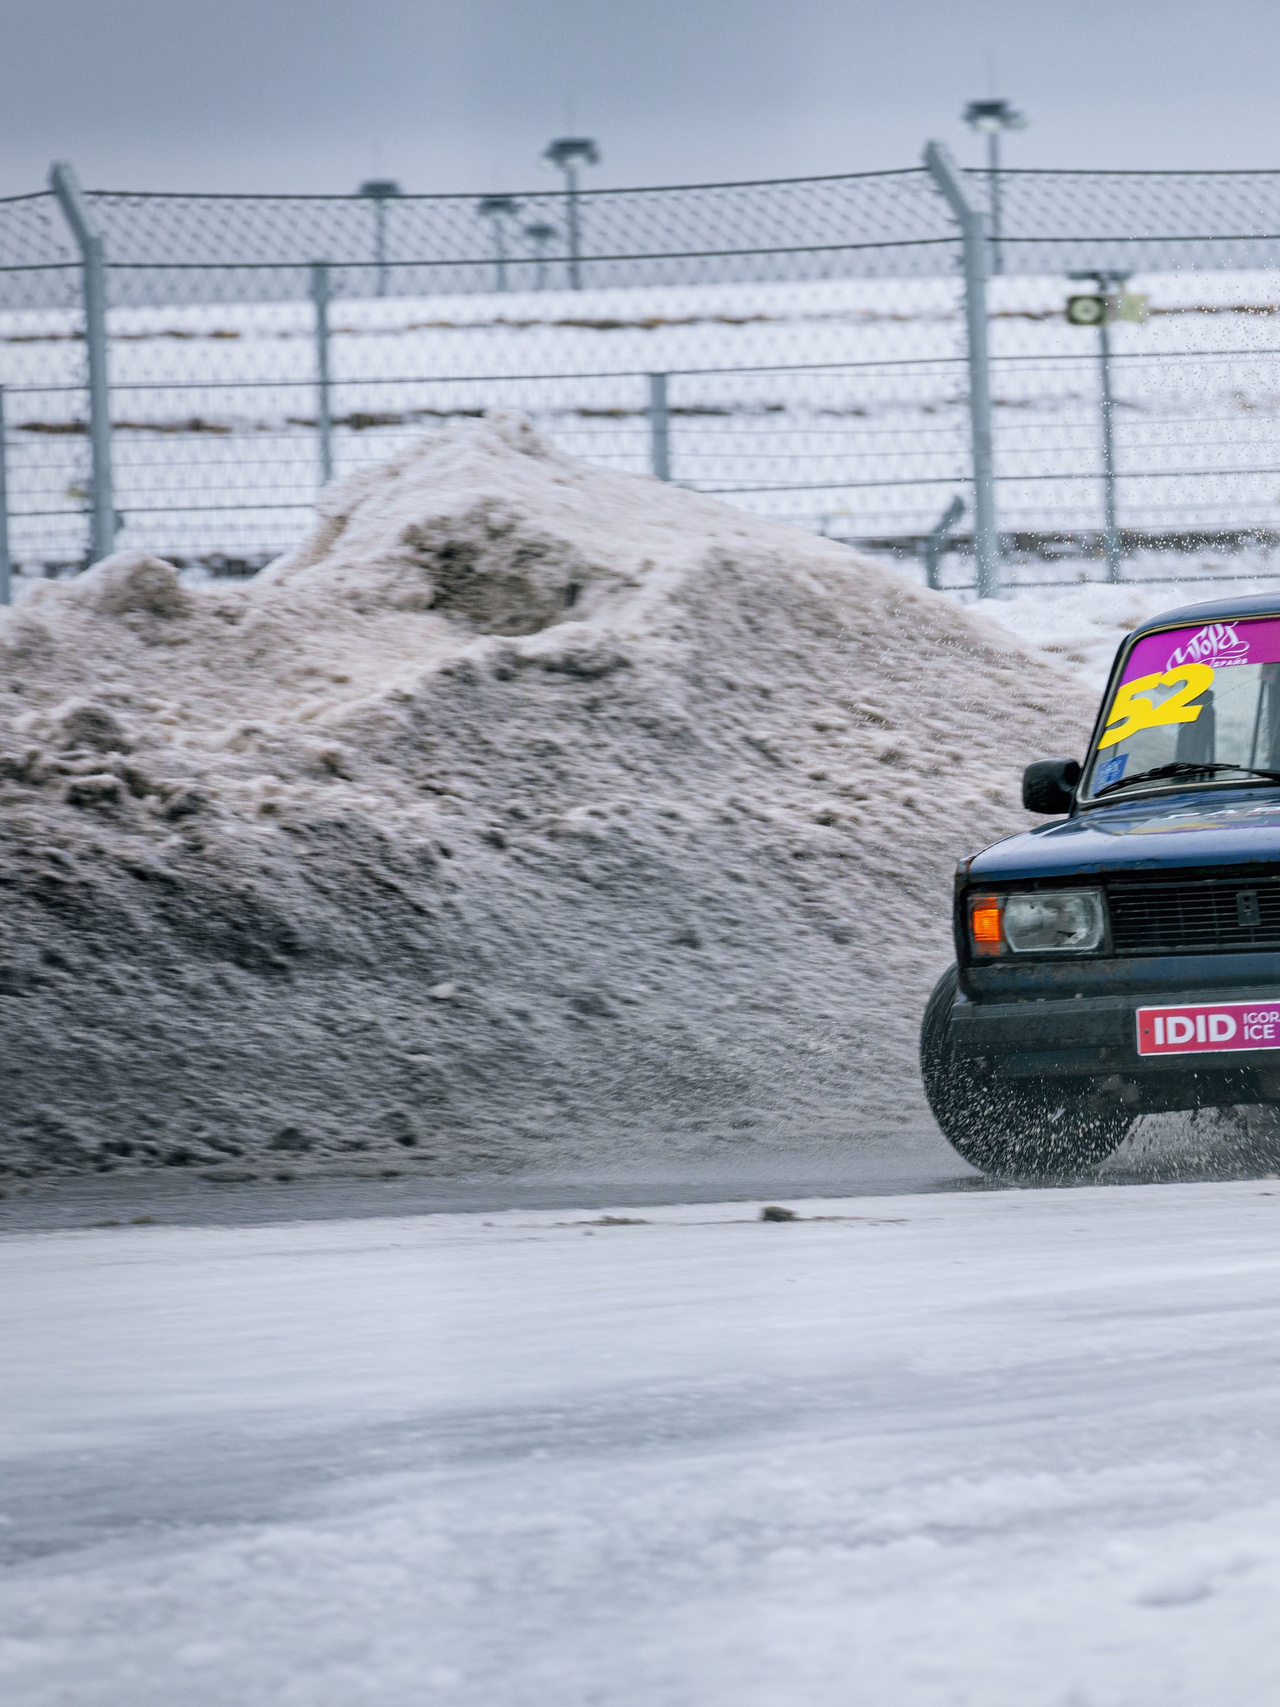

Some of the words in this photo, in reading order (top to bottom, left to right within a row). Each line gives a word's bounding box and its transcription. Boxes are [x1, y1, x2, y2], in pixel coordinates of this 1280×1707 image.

[1097, 663, 1215, 750] 52
[1154, 1014, 1237, 1045] IDID
[1243, 1024, 1276, 1040] ICE
